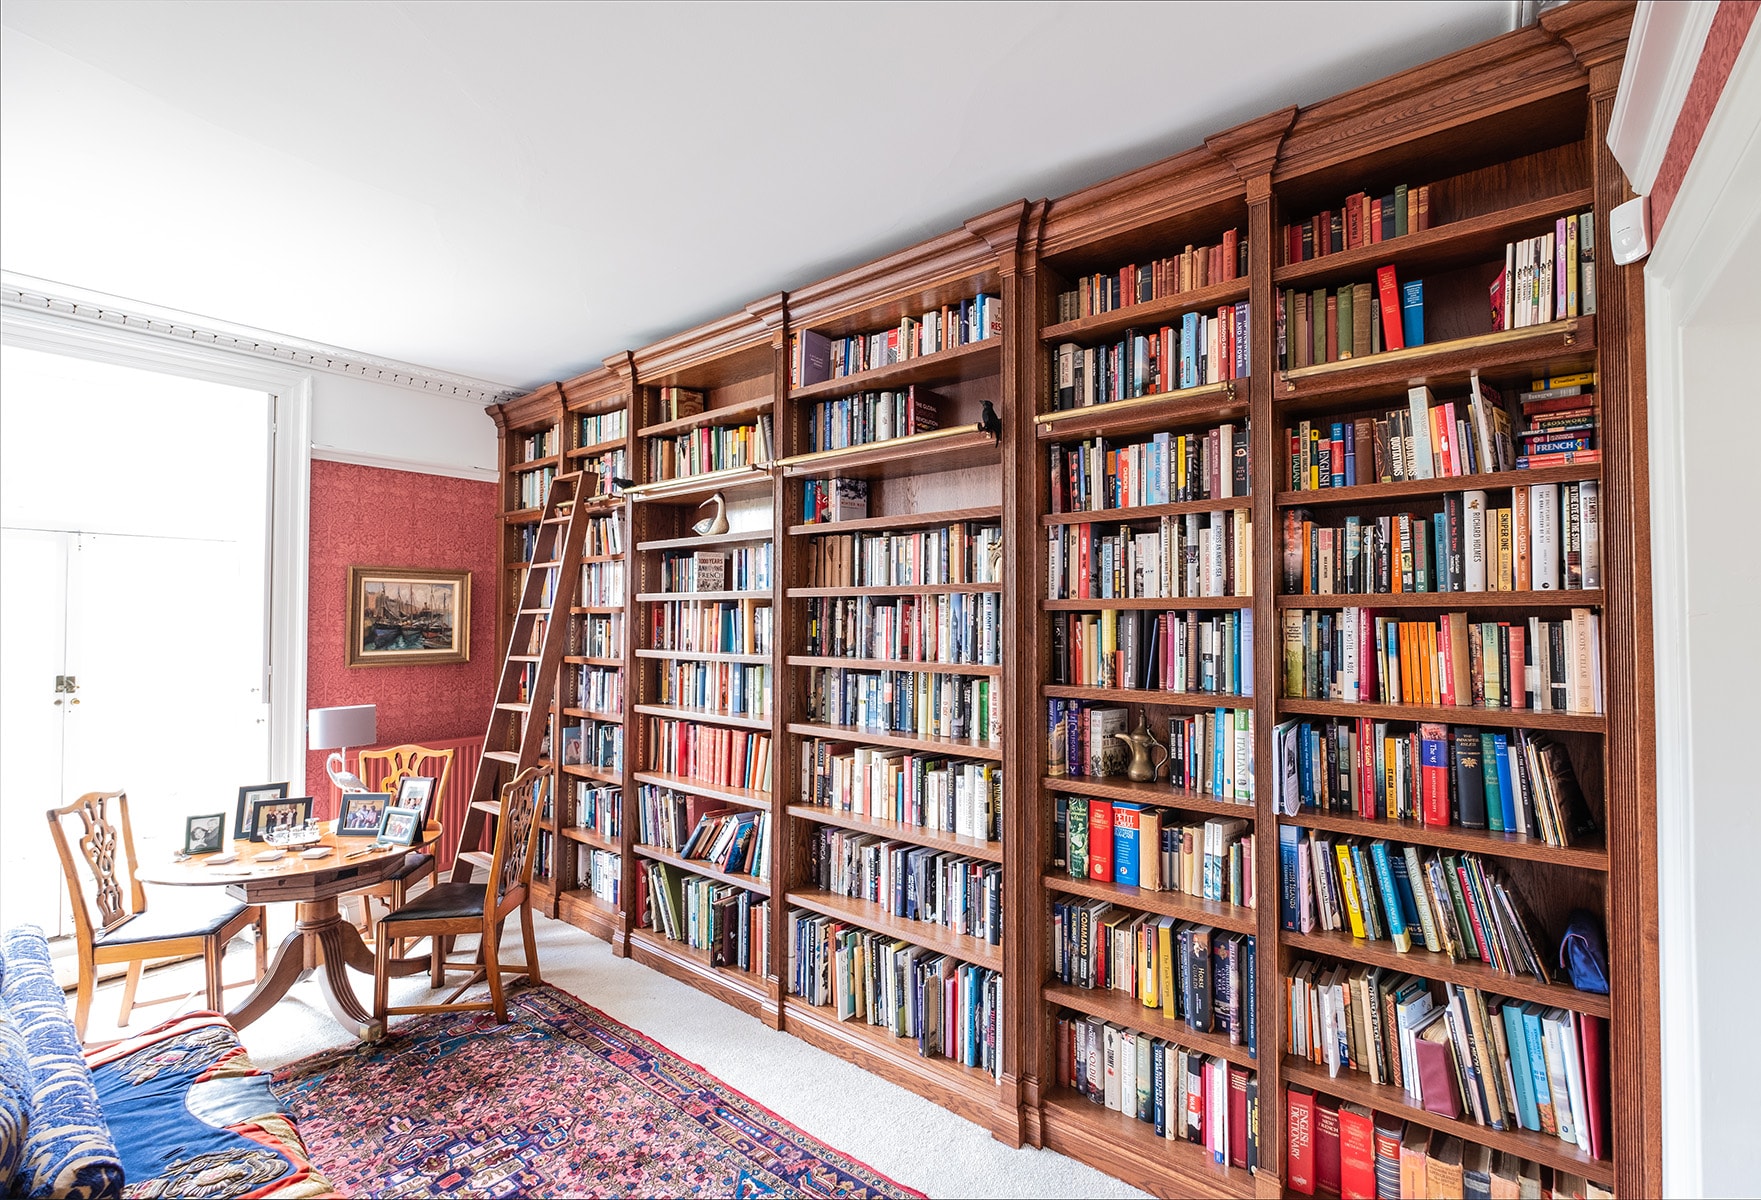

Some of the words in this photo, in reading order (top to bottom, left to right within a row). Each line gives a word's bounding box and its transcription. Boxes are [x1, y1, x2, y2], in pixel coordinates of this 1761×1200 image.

[1542, 418, 1587, 427] CROSSWORD
[1390, 436, 1404, 476] QUOTATIONS
[1404, 436, 1418, 476] QUOTATIONS
[1536, 442, 1573, 452] FRENCH
[1319, 450, 1330, 486] ENGLISH
[1571, 492, 1579, 502] THE
[1572, 504, 1580, 512] EYE
[1400, 516, 1410, 532] SHOOT
[1472, 512, 1480, 537] RICHARD
[1500, 514, 1508, 537] SNIPER
[1572, 522, 1580, 532] THE
[1401, 540, 1410, 552] KILL
[1474, 538, 1482, 562] HOLMES
[1572, 533, 1580, 552] STORM
[1236, 737, 1245, 776] ITALIAN
[1115, 814, 1134, 822] PETIT
[1377, 848, 1386, 876] HAMMOND
[1291, 1106, 1299, 1160] DICTIONARY
[1299, 1109, 1308, 1147] ENGLISH
[1318, 1122, 1338, 1133] FRENCH
